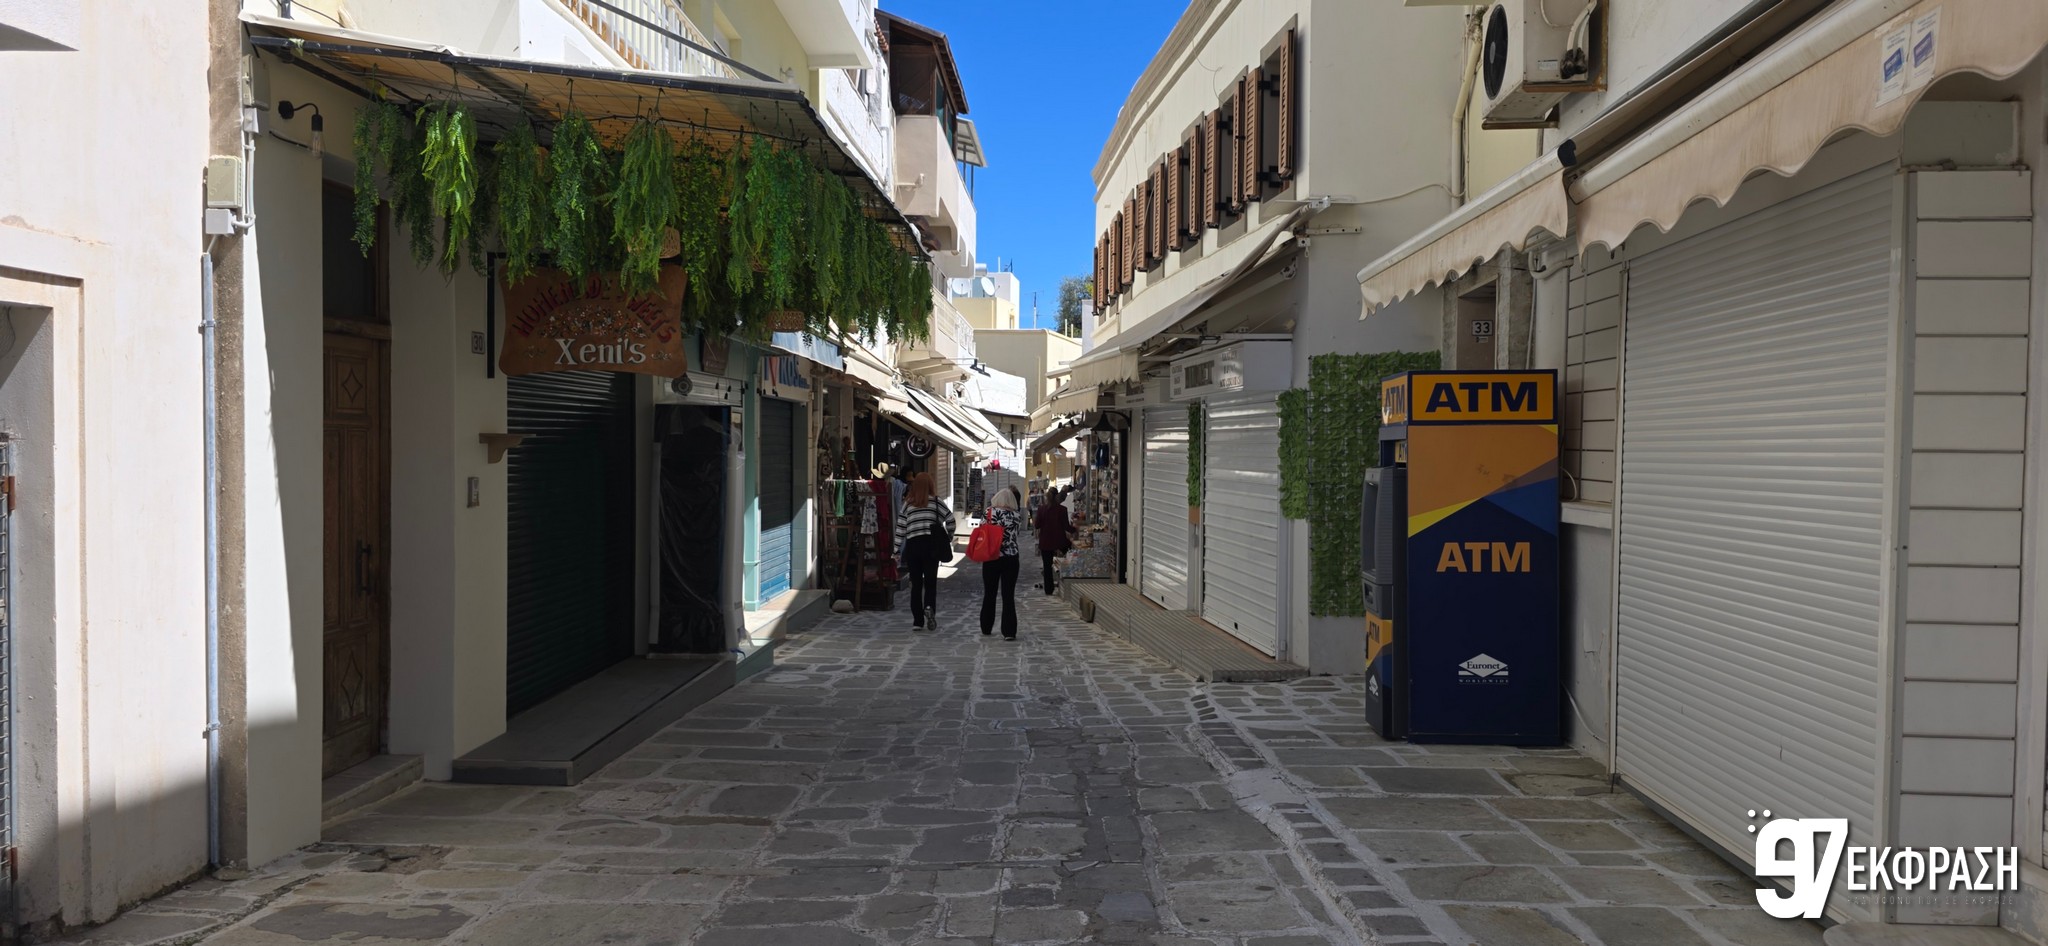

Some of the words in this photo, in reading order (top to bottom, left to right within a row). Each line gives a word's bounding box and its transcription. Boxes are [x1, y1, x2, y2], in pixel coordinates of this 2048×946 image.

[511, 276, 613, 337] HOMEMDE
[1475, 322, 1490, 333] 33
[473, 335, 483, 351] 30
[555, 337, 648, 366] Xeni's
[1385, 384, 1405, 415] ATM
[1425, 381, 1538, 413] ATM
[1436, 541, 1531, 573] ATM
[1369, 620, 1380, 643] ATM
[1466, 661, 1501, 670] Euronet
